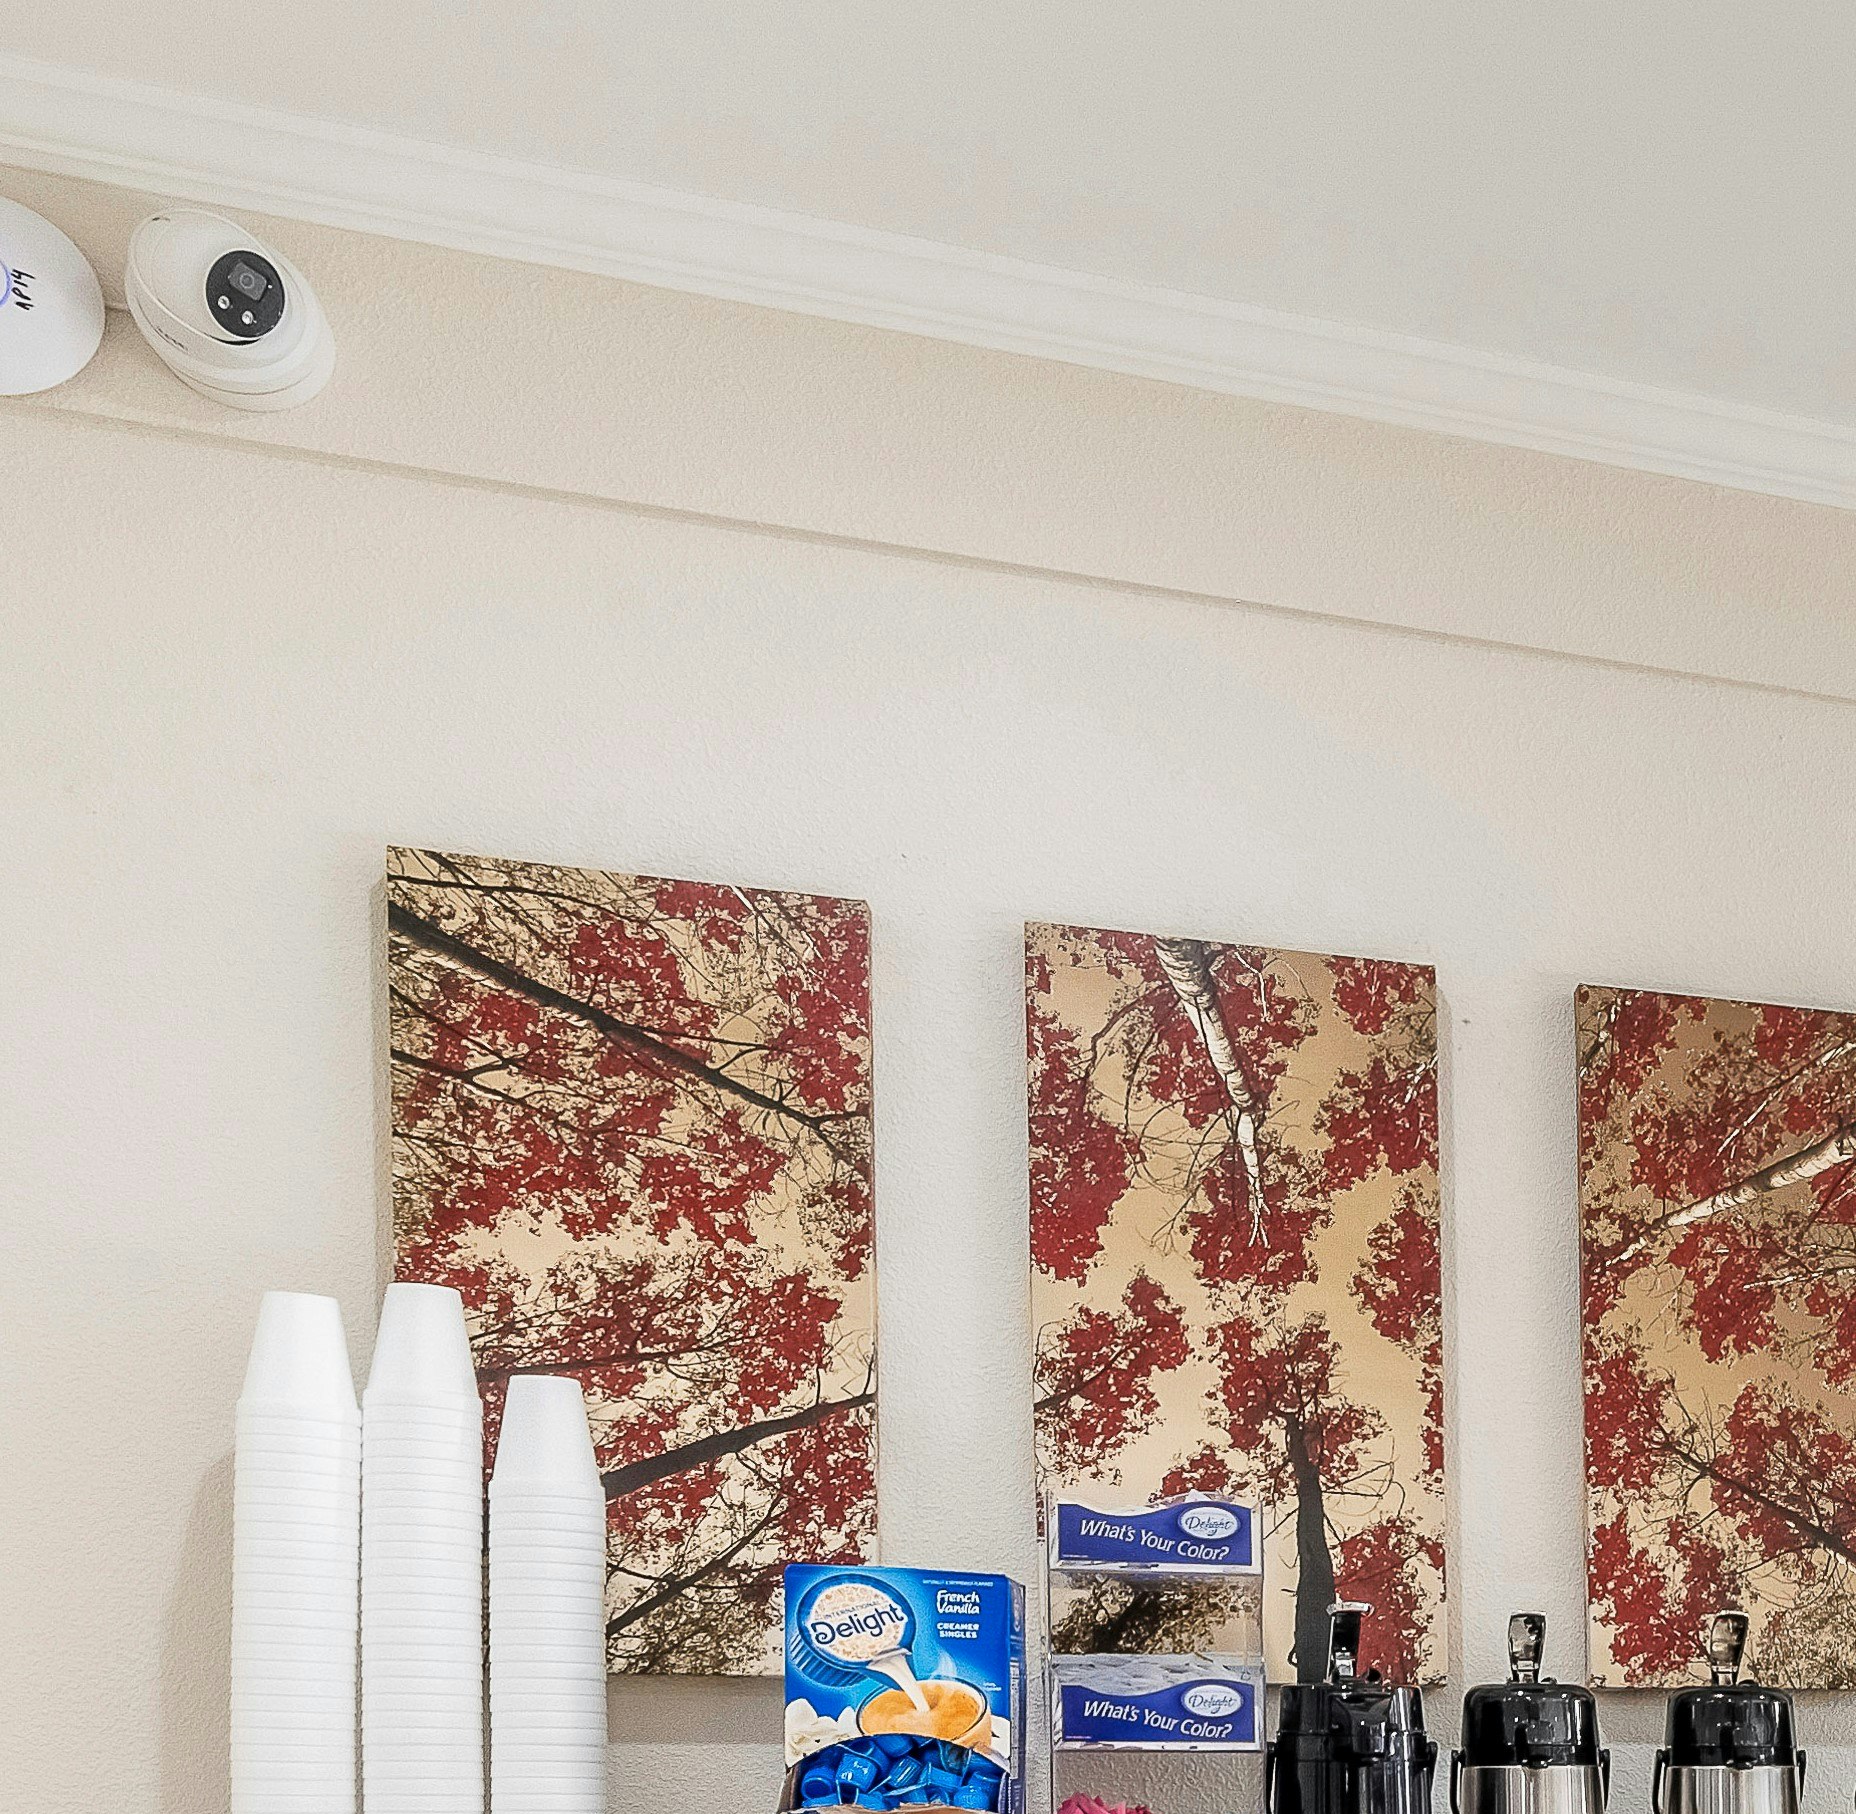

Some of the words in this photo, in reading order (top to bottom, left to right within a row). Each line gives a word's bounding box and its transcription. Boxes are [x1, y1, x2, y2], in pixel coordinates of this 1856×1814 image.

[1080, 1519, 1136, 1542] What's
[1139, 1530, 1175, 1552] Your
[1177, 1540, 1230, 1560] Color?
[936, 1589, 980, 1604] French
[936, 1601, 980, 1614] Vanilla
[811, 1604, 904, 1644] Delight
[1083, 1701, 1140, 1722] What's
[1143, 1708, 1180, 1731] Your
[1180, 1719, 1233, 1739] Color?
